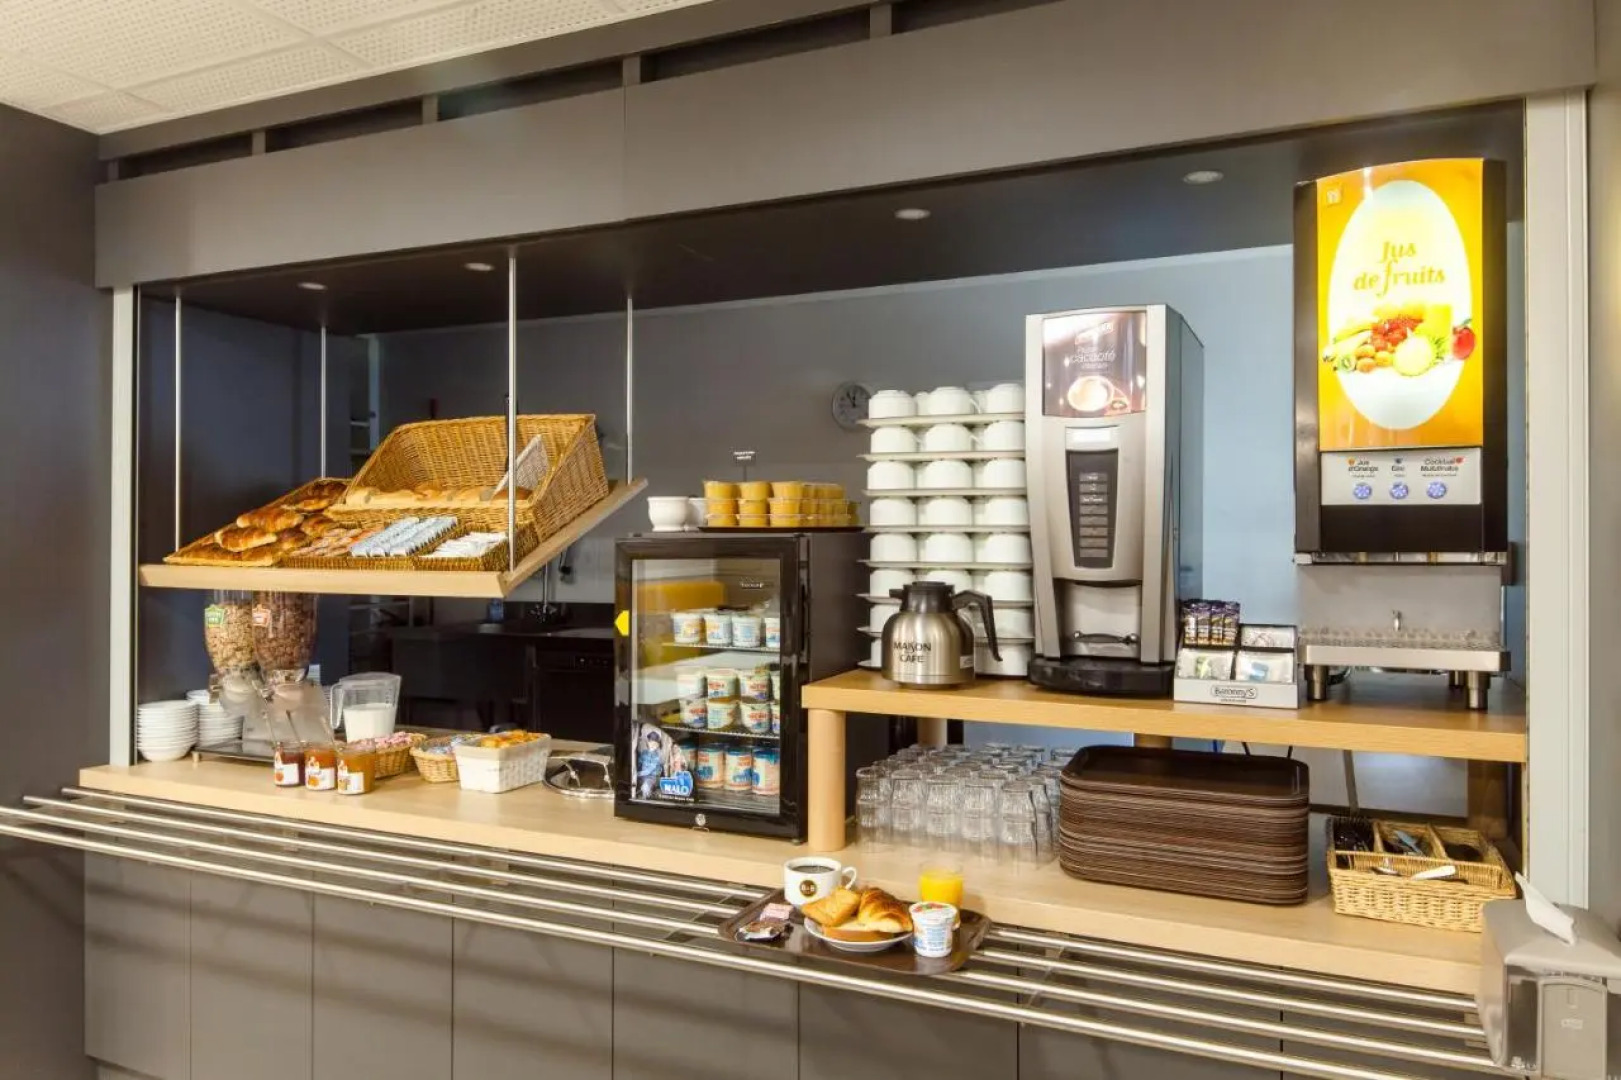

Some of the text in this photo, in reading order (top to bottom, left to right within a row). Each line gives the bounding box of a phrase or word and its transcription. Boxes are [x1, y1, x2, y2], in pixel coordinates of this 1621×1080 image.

[1379, 241, 1417, 263] Jus
[1353, 261, 1446, 297] de fruits
[893, 642, 932, 653] MAISON
